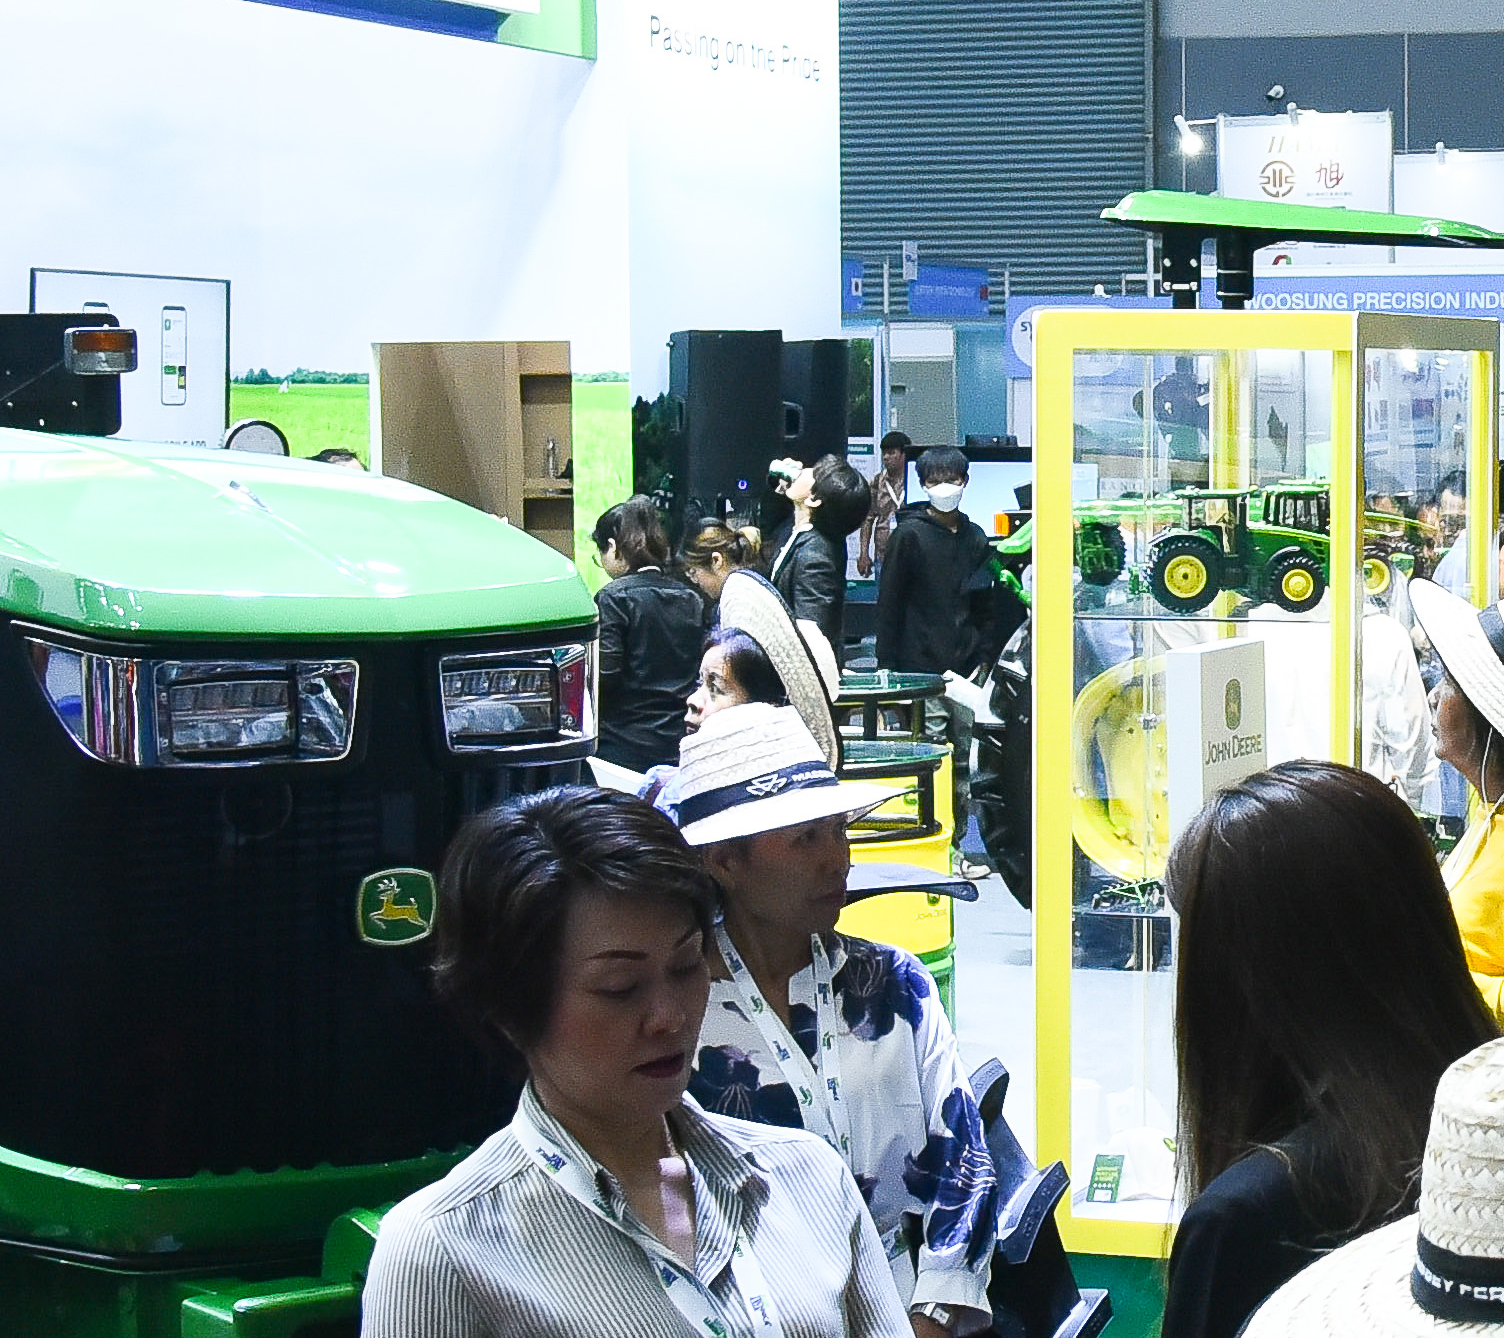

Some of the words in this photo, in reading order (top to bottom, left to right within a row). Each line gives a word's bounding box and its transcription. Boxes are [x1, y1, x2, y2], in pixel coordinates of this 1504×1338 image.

[1353, 292, 1456, 310] PRECISION
[1205, 739, 1230, 765] JOHN
[1231, 734, 1263, 759] DEERE
